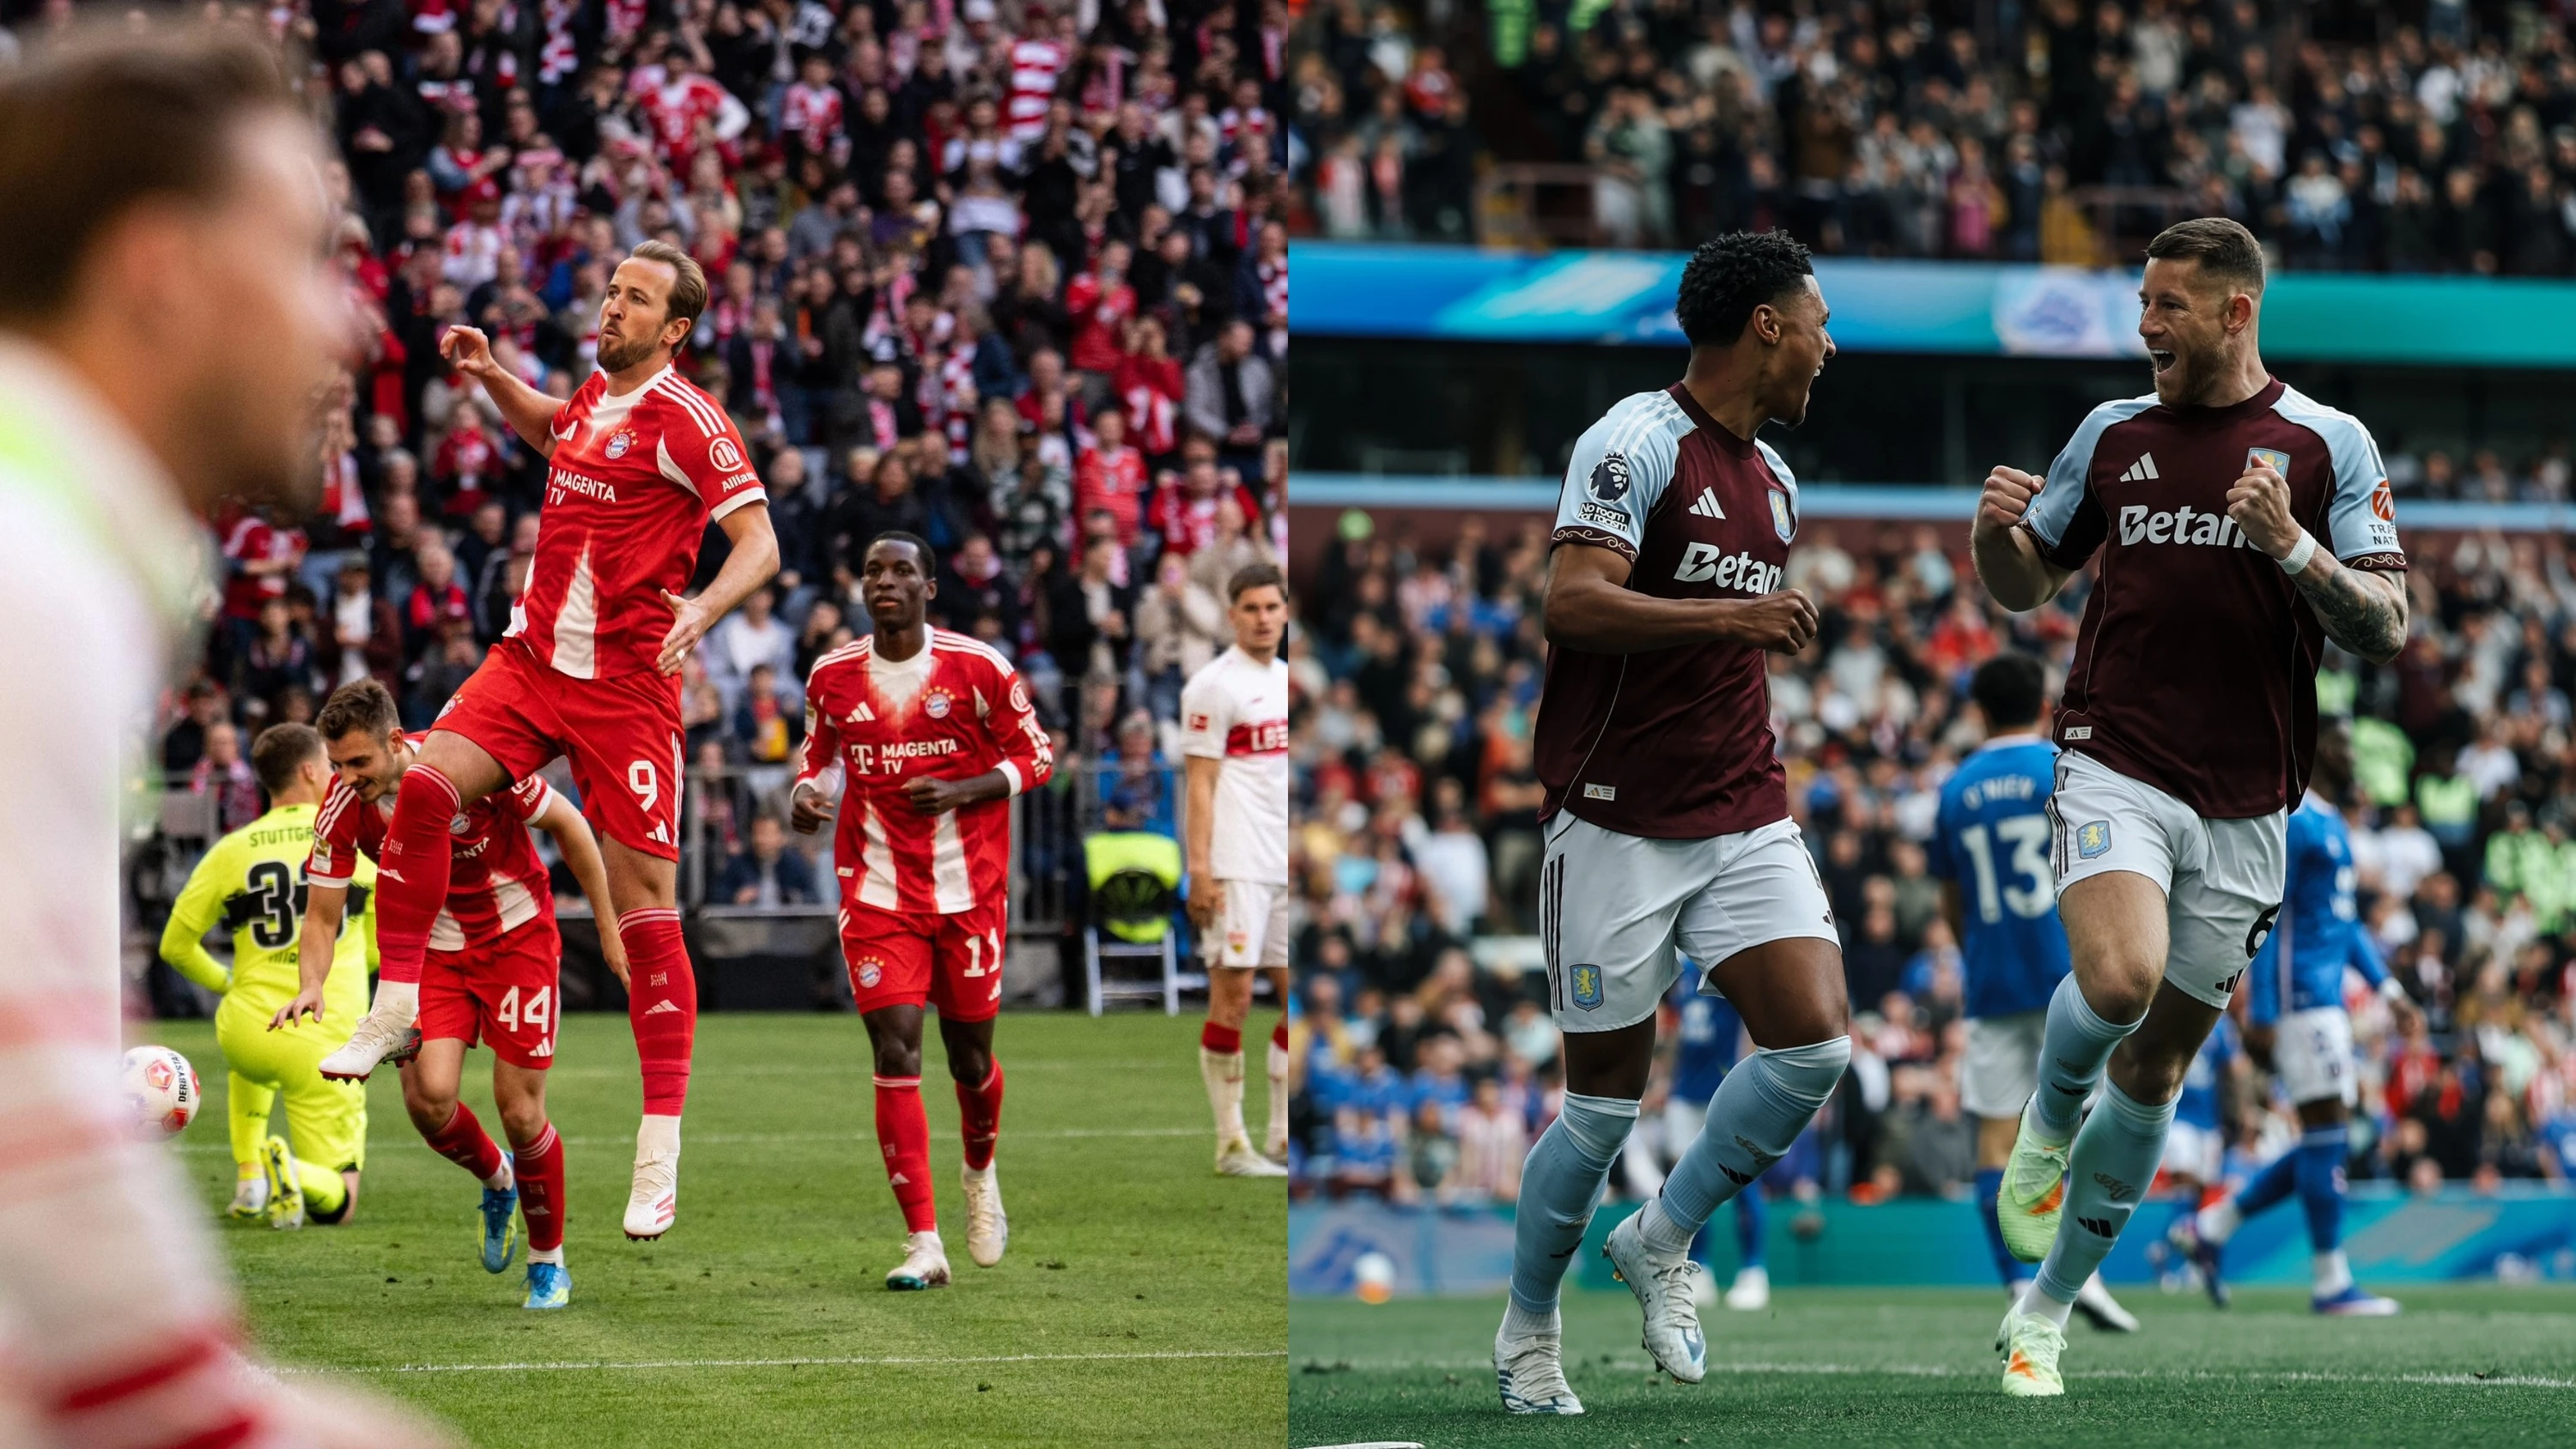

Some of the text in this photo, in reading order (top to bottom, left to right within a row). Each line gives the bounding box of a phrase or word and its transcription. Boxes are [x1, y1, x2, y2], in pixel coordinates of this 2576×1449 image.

[550, 487, 567, 506] TV
[554, 468, 617, 503] MAGENTA
[1580, 503, 1625, 523] No room
[1593, 513, 1628, 533] racism
[2119, 505, 2263, 552] Betan
[1674, 542, 1785, 596] Betan
[881, 738, 958, 759] MAGENTA
[881, 759, 903, 774] TV
[629, 761, 659, 813] 9
[1960, 814, 2057, 925] 13
[963, 927, 1001, 977] 11
[2245, 901, 2283, 960] 6
[498, 985, 551, 1034] 44
